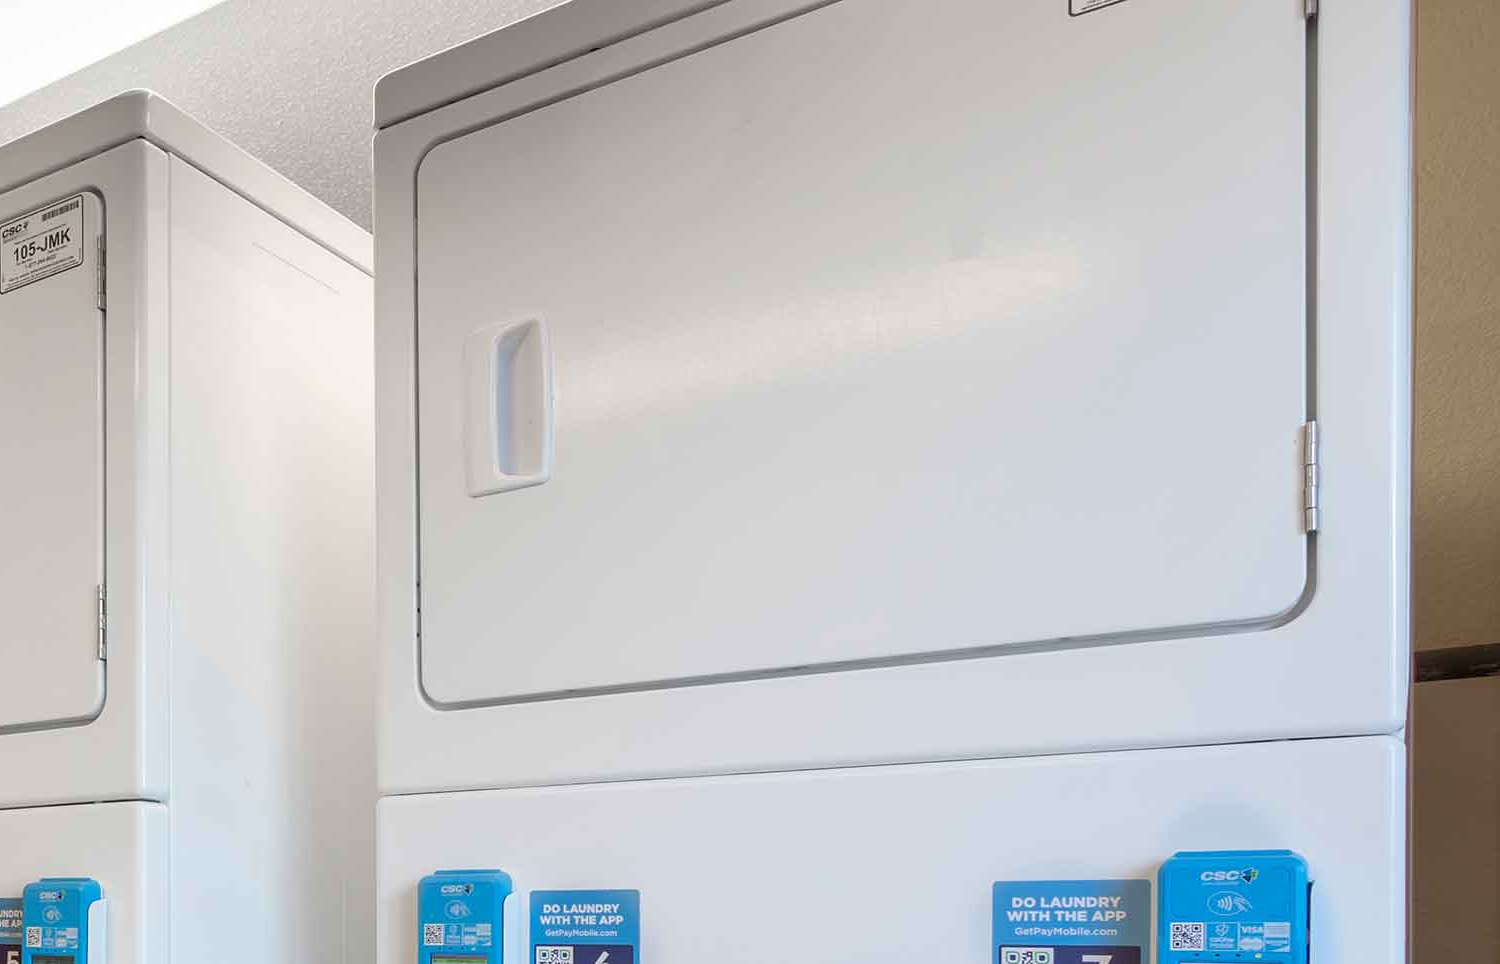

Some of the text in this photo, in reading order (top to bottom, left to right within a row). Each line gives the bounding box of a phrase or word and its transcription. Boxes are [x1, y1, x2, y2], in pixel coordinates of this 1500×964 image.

[13, 227, 71, 262] 105-JMK
[1201, 870, 1239, 881] CSC
[1011, 896, 1121, 908] DO LAUNDRY
[543, 904, 620, 913] DO LAUNDRY
[540, 915, 624, 925] WITH THE APP
[1006, 910, 1127, 921] WITH THE APP
[11, 919, 22, 927] AP
[545, 929, 618, 937] GetPayMobile.com
[1014, 927, 1118, 936] GetPayMobile.com
